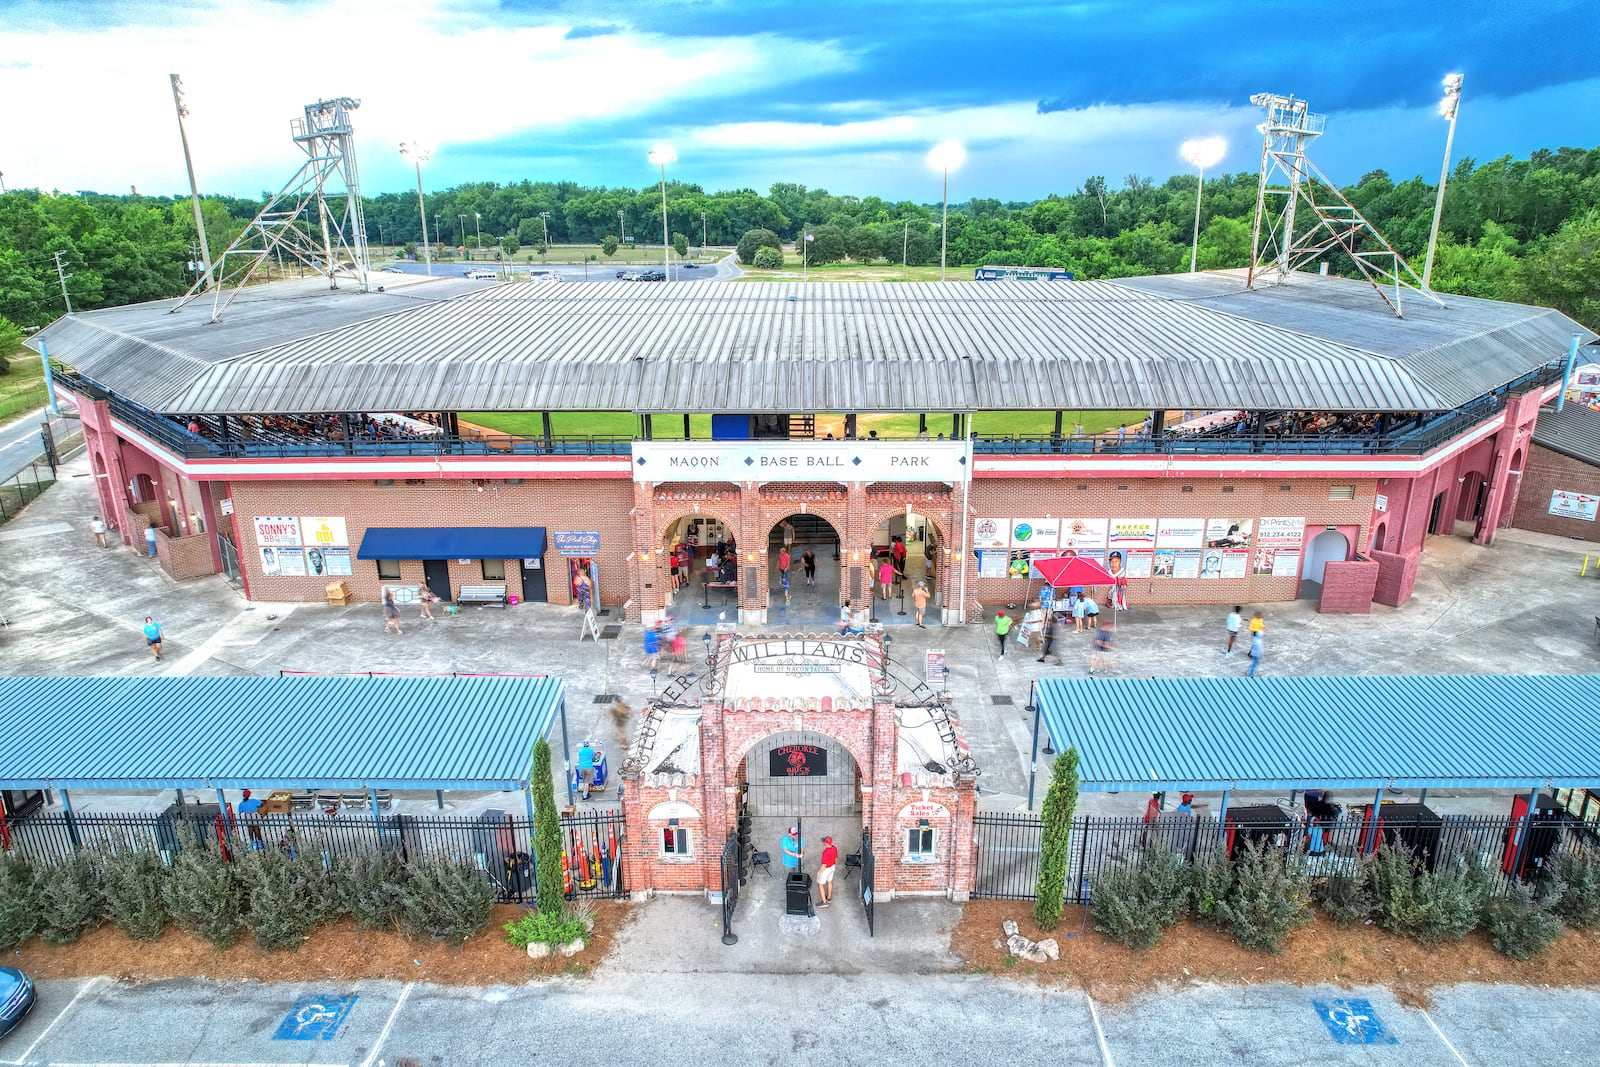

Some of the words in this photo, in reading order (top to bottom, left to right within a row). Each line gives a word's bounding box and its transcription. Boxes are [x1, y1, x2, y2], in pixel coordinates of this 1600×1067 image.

[669, 455, 720, 467] MACON
[760, 455, 799, 467] BASE
[807, 455, 845, 467] BALL
[890, 455, 930, 467] PARK
[258, 524, 297, 535] SONNY'S
[263, 534, 281, 543] BBQ
[637, 675, 692, 750] LUTHER
[732, 640, 865, 663] WILLIAMS
[912, 681, 957, 743] FIELD
[777, 745, 819, 756] CHEROKEE
